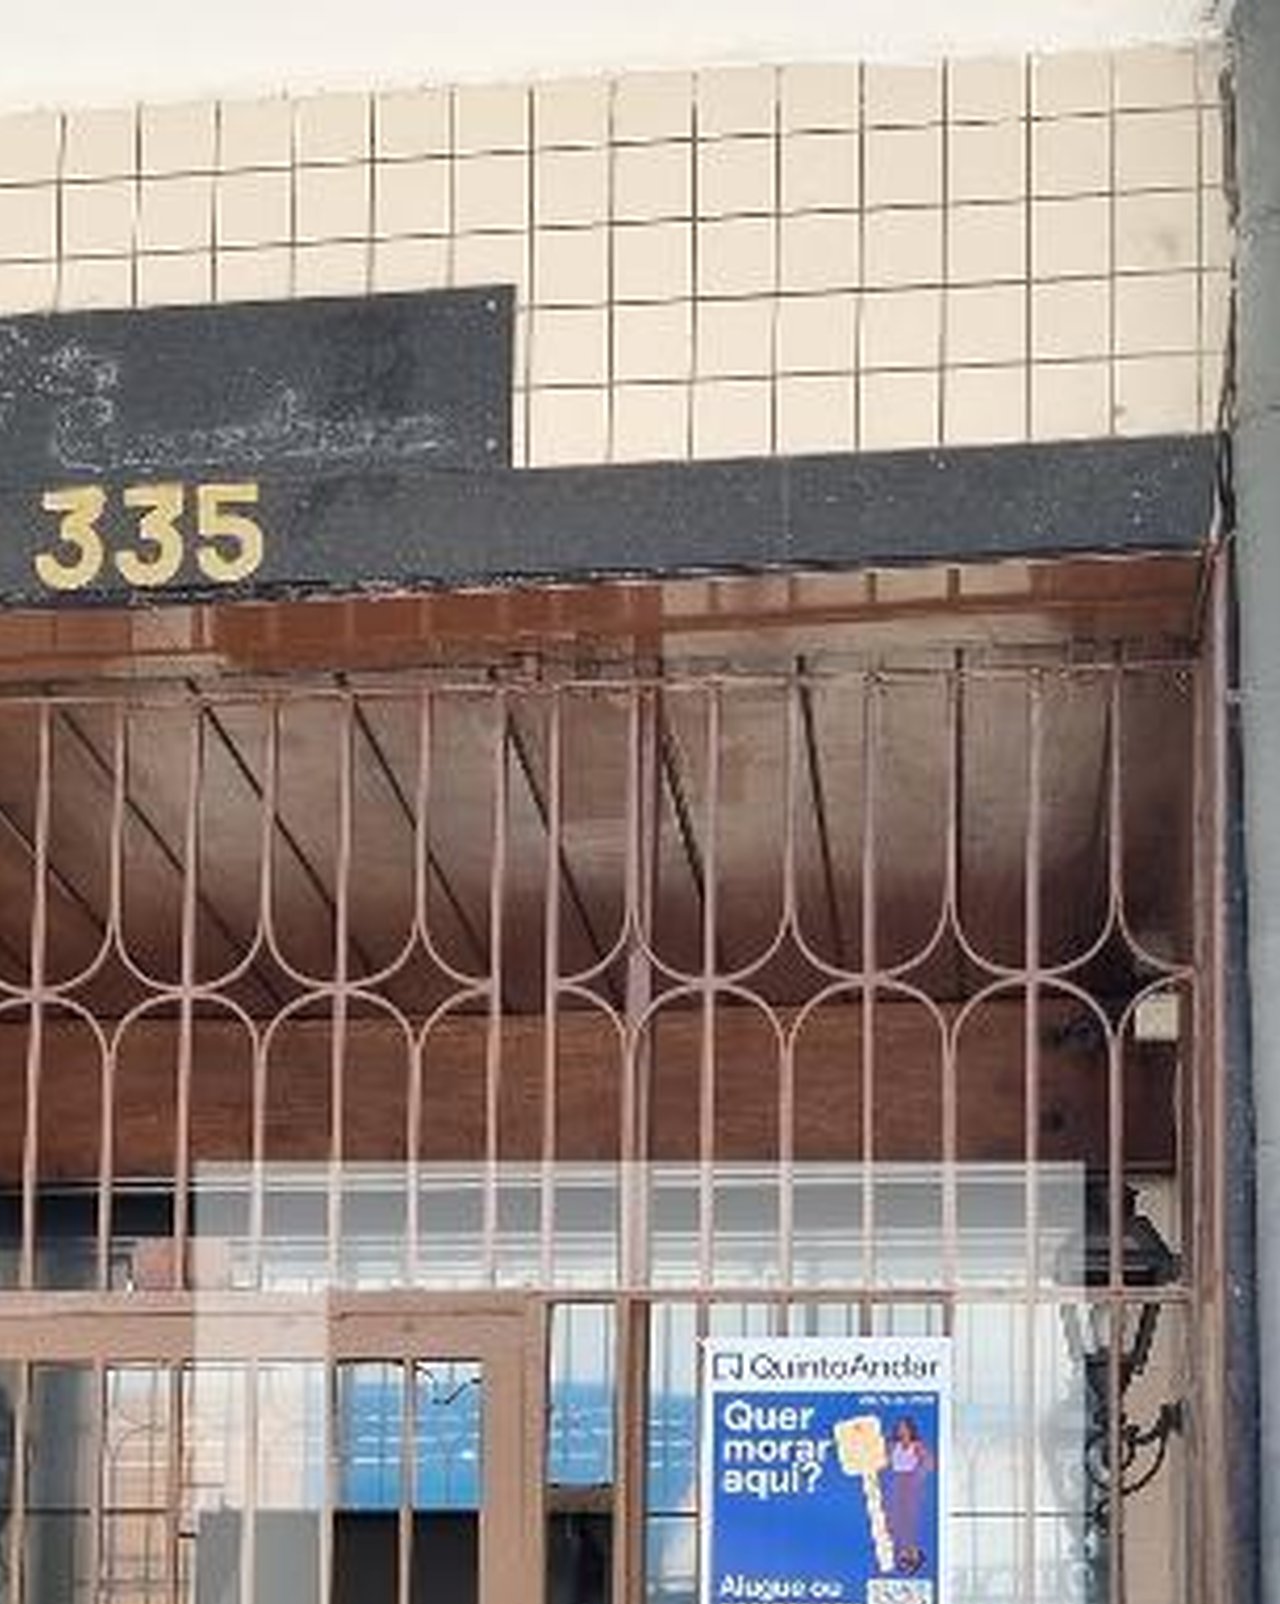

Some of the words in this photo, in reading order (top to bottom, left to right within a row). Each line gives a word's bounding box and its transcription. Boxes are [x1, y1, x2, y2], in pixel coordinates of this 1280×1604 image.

[33, 482, 266, 591] 335
[749, 1353, 939, 1382] QuintoAndar
[723, 1399, 816, 1433] Quer
[723, 1438, 832, 1462] morar
[723, 1462, 823, 1500] aqui?
[719, 1573, 807, 1601] Alugue
[809, 1581, 844, 1598] ou
